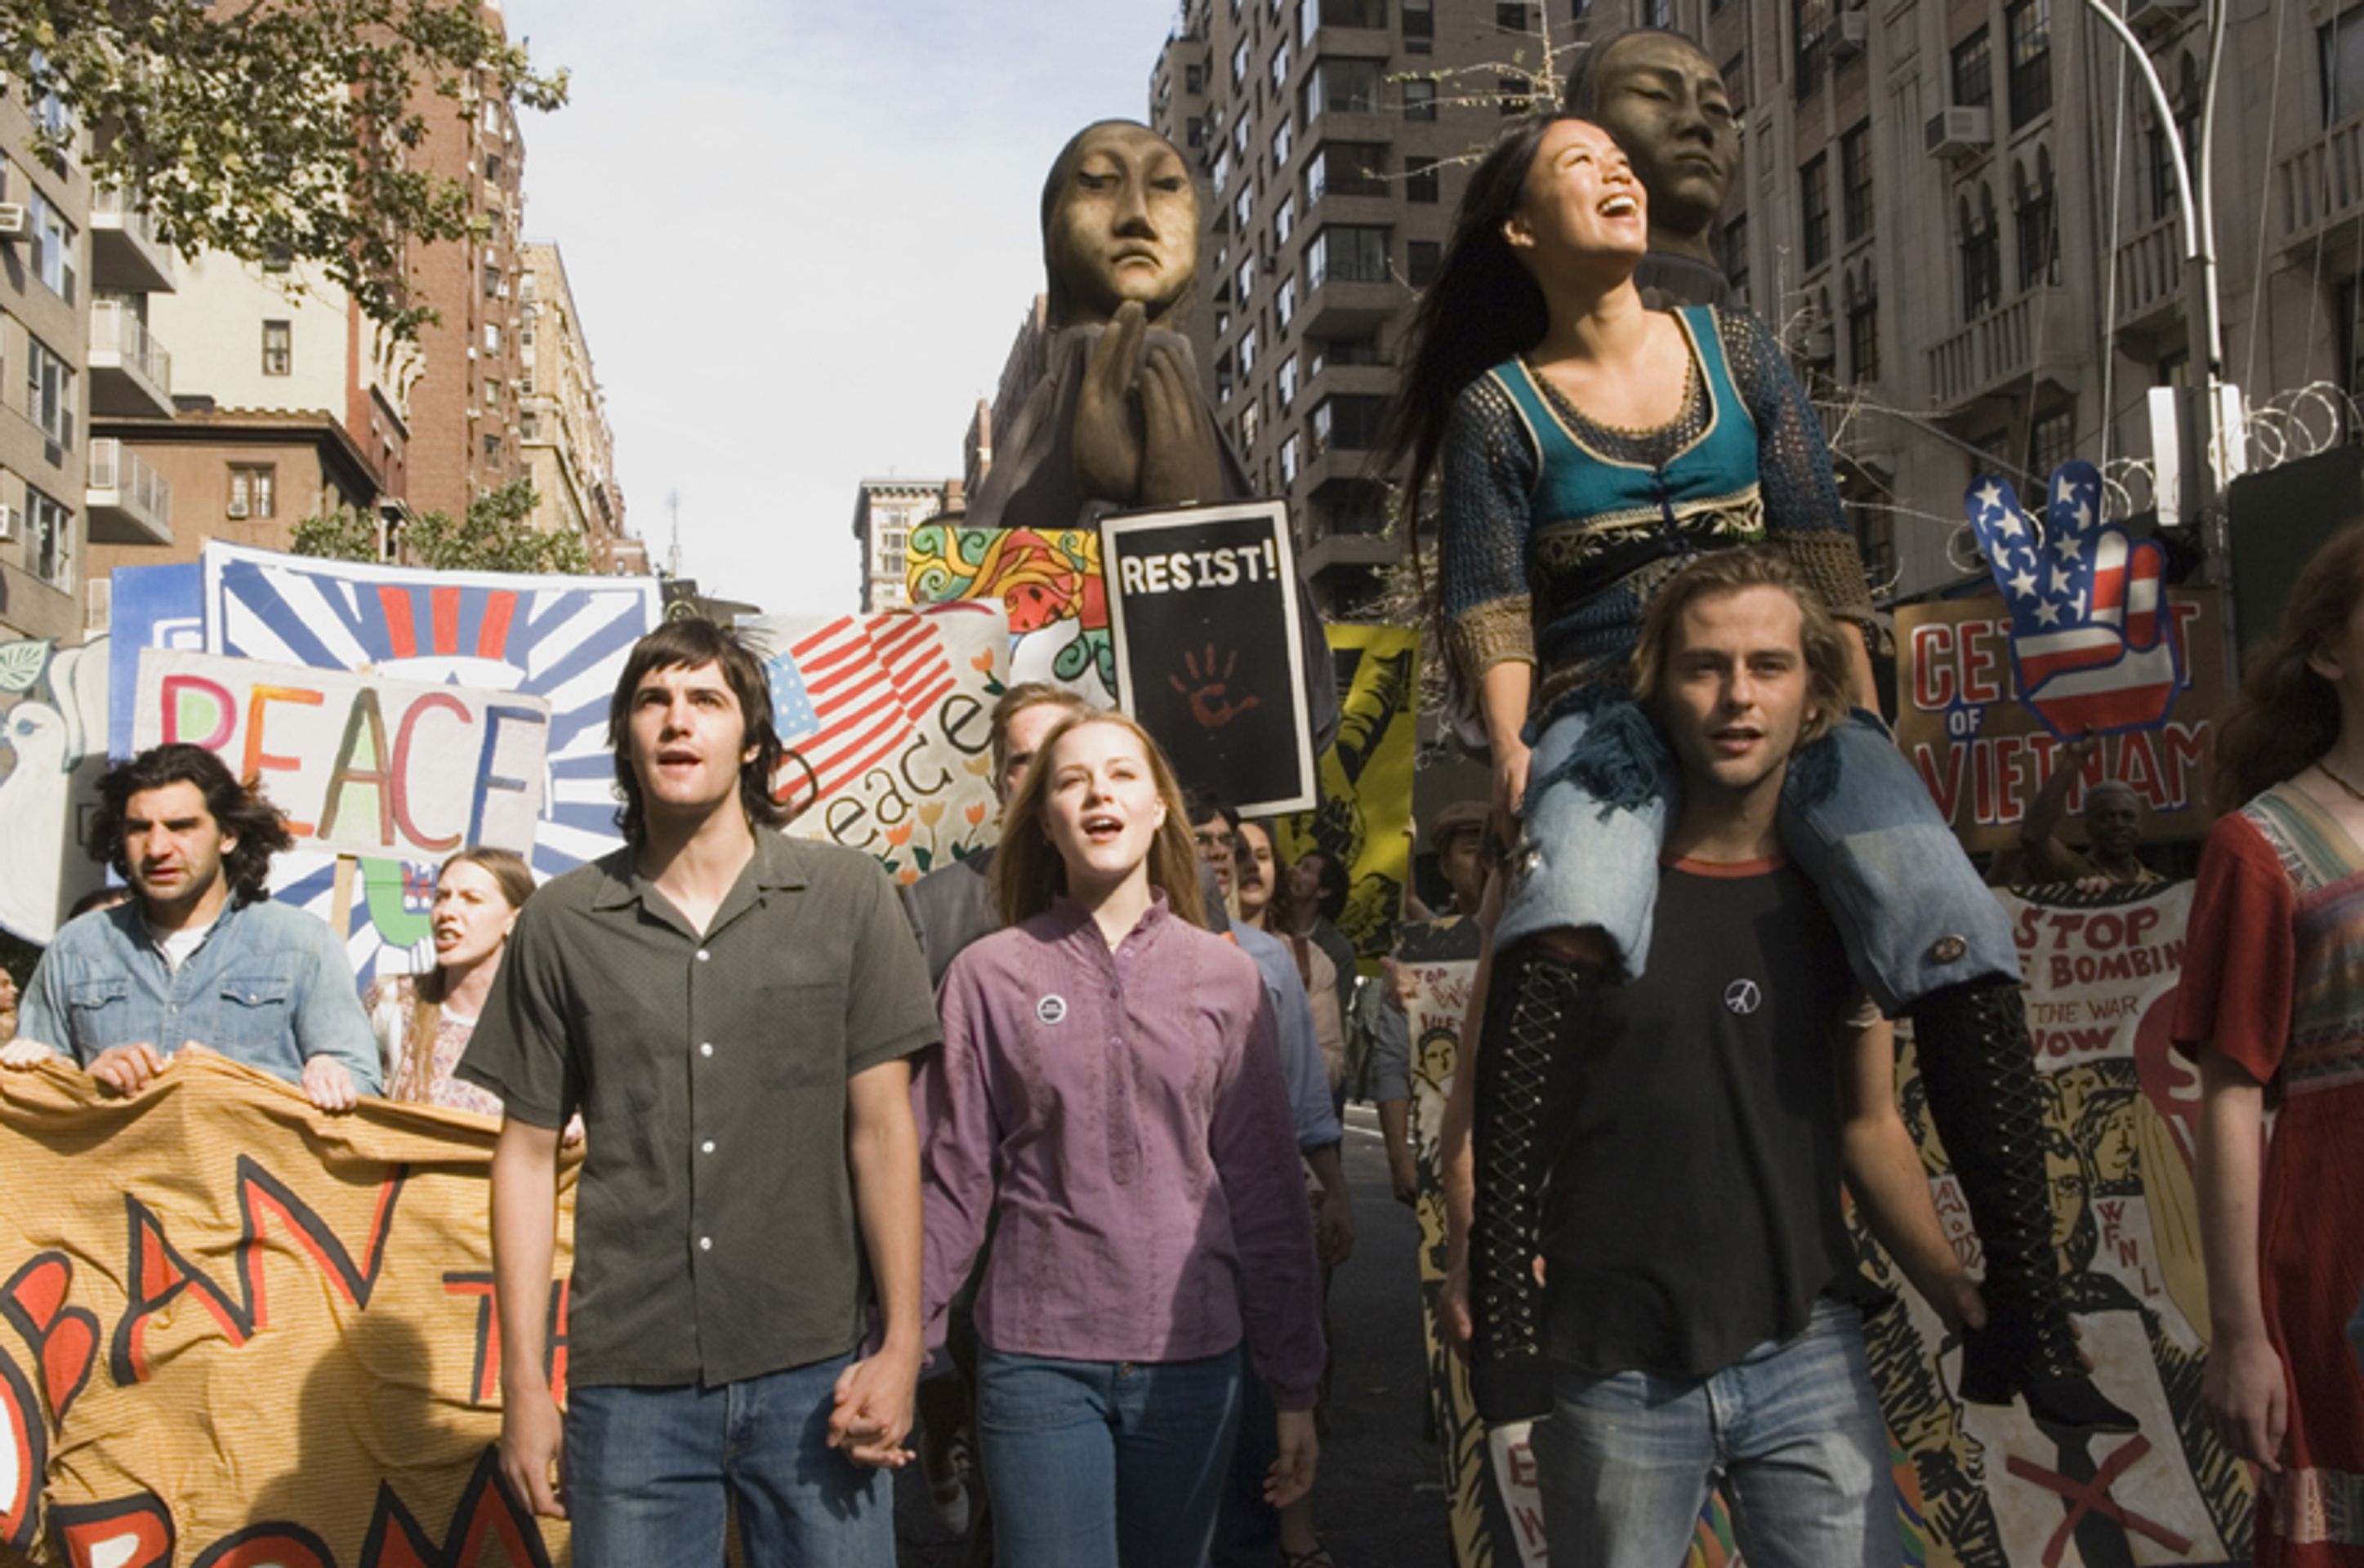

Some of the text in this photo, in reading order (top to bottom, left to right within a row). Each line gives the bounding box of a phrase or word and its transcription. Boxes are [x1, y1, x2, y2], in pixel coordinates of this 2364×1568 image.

[1121, 539, 1277, 595] RESIST!
[1911, 620, 2024, 710] GE
[1948, 708, 1983, 735] OF
[160, 675, 546, 856] PEACE
[2014, 906, 2160, 951] STOP
[2050, 939, 2190, 989] BOMBIN
[2032, 995, 2139, 1024] THE WAR
